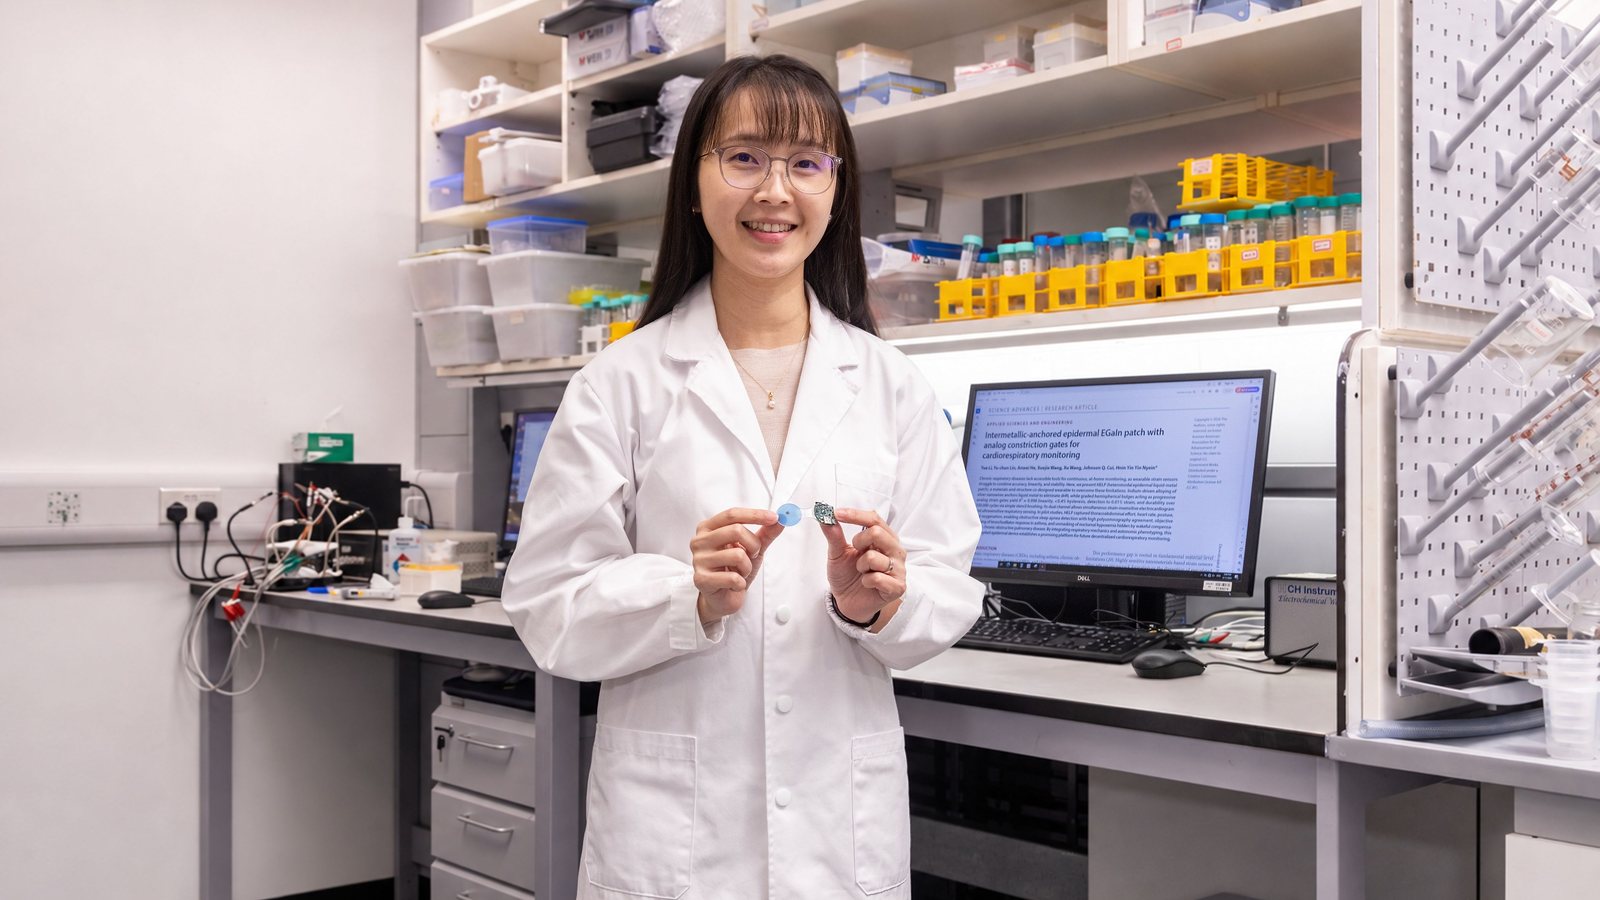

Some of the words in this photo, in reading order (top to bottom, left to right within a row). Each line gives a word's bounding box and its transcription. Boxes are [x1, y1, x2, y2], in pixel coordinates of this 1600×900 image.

[984, 430, 1062, 440] Intermetallic-anchored
[1062, 429, 1100, 440] epidermal
[1123, 428, 1146, 438] patch
[1147, 427, 1165, 437] with
[983, 441, 1007, 451] analog
[1007, 441, 1048, 449] constriction
[1049, 442, 1068, 450] gates
[1068, 440, 1080, 449] for
[982, 452, 1040, 461] cardiorespiratory
[1040, 451, 1081, 460] monitoring
[1287, 584, 1302, 594] CH
[1278, 594, 1327, 605] Electrochemical
